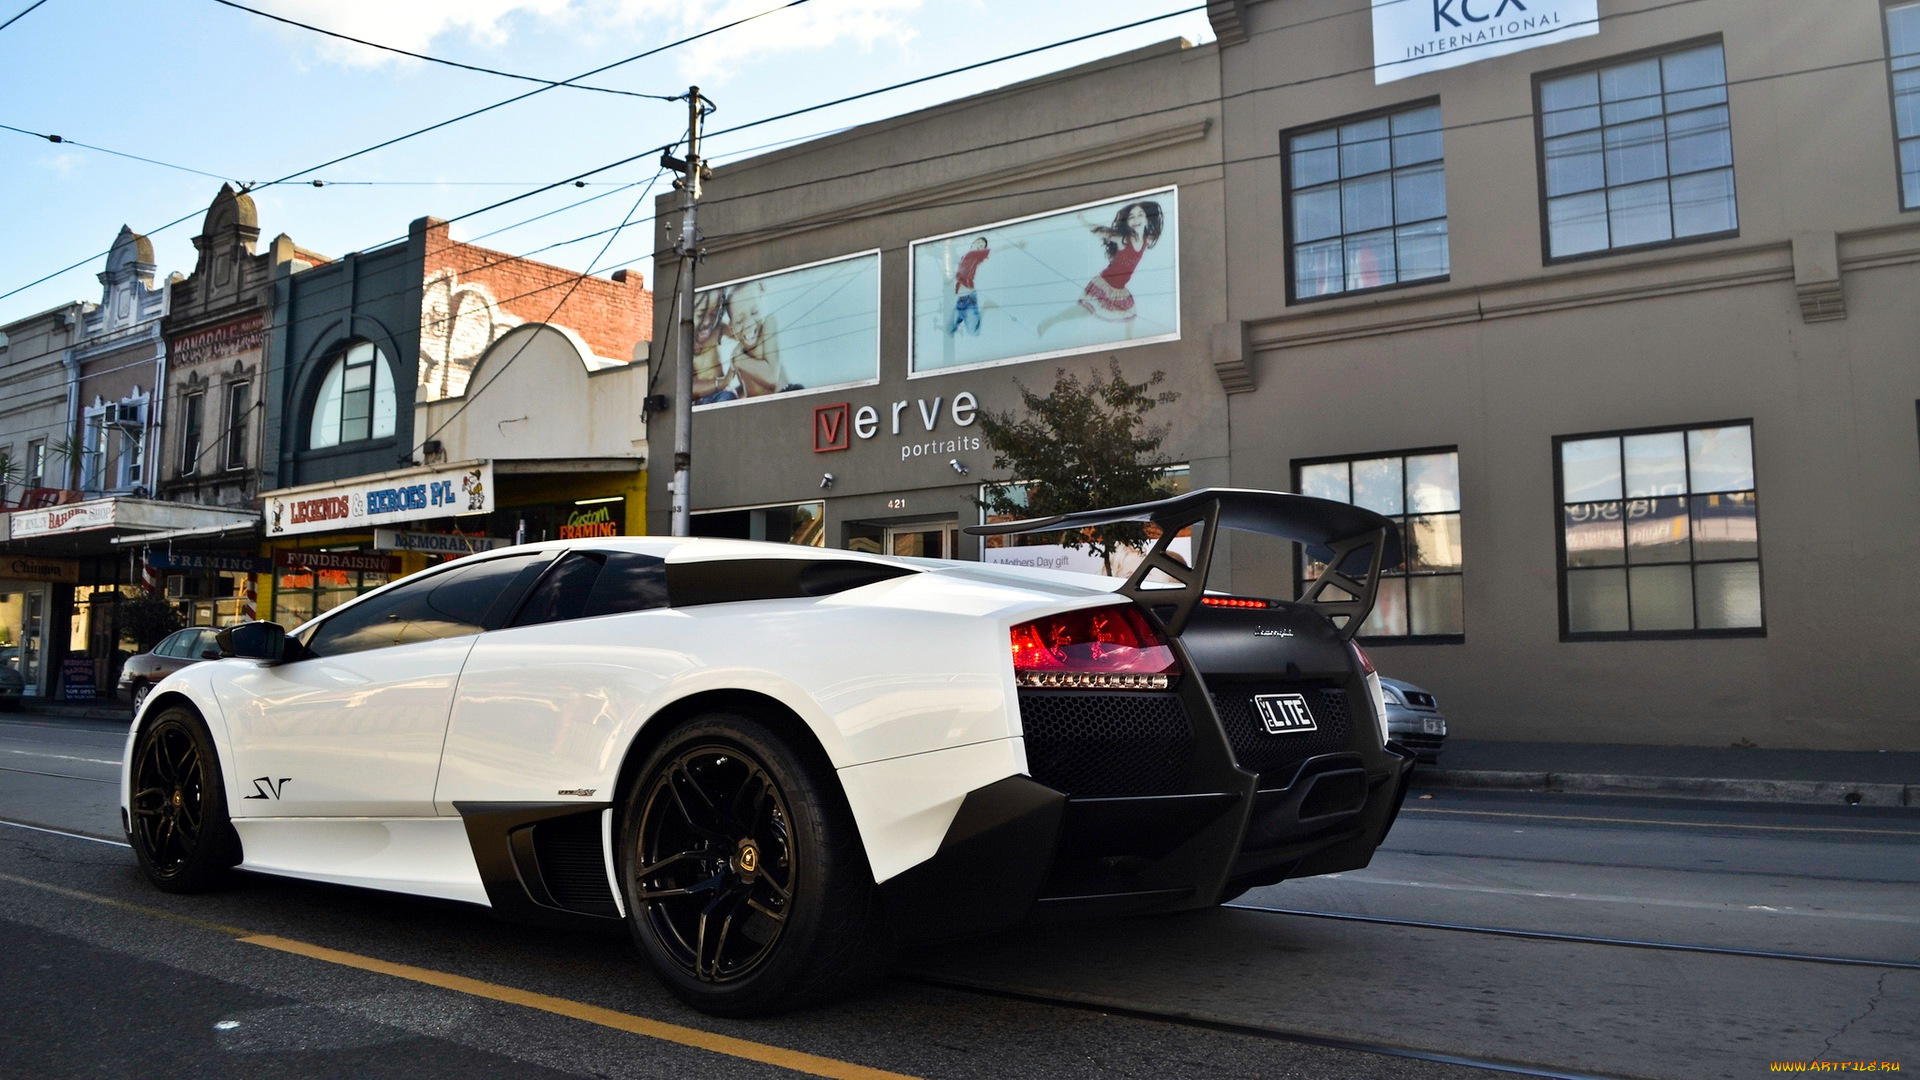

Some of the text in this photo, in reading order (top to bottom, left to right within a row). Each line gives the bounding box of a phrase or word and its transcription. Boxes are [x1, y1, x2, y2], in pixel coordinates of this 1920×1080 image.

[1406, 11, 1561, 58] INTERNATIONAL
[820, 391, 979, 443] verve
[901, 436, 980, 461] portraits
[290, 480, 456, 524] LEGENDS & HEROES P/L
[887, 499, 905, 509] 421
[48, 508, 87, 530] BARBER
[88, 506, 111, 521] SHOP
[568, 506, 610, 527] Custom
[395, 534, 493, 551] MEMORABLIA
[560, 521, 617, 540] FRAMING
[169, 555, 253, 570] FRAMING
[1001, 558, 1034, 568] Mothers
[1036, 557, 1054, 569] Day
[1055, 555, 1069, 568] gift
[1259, 700, 1275, 727] VIC
[1265, 699, 1311, 727] LITE
[243, 776, 292, 800] SV
